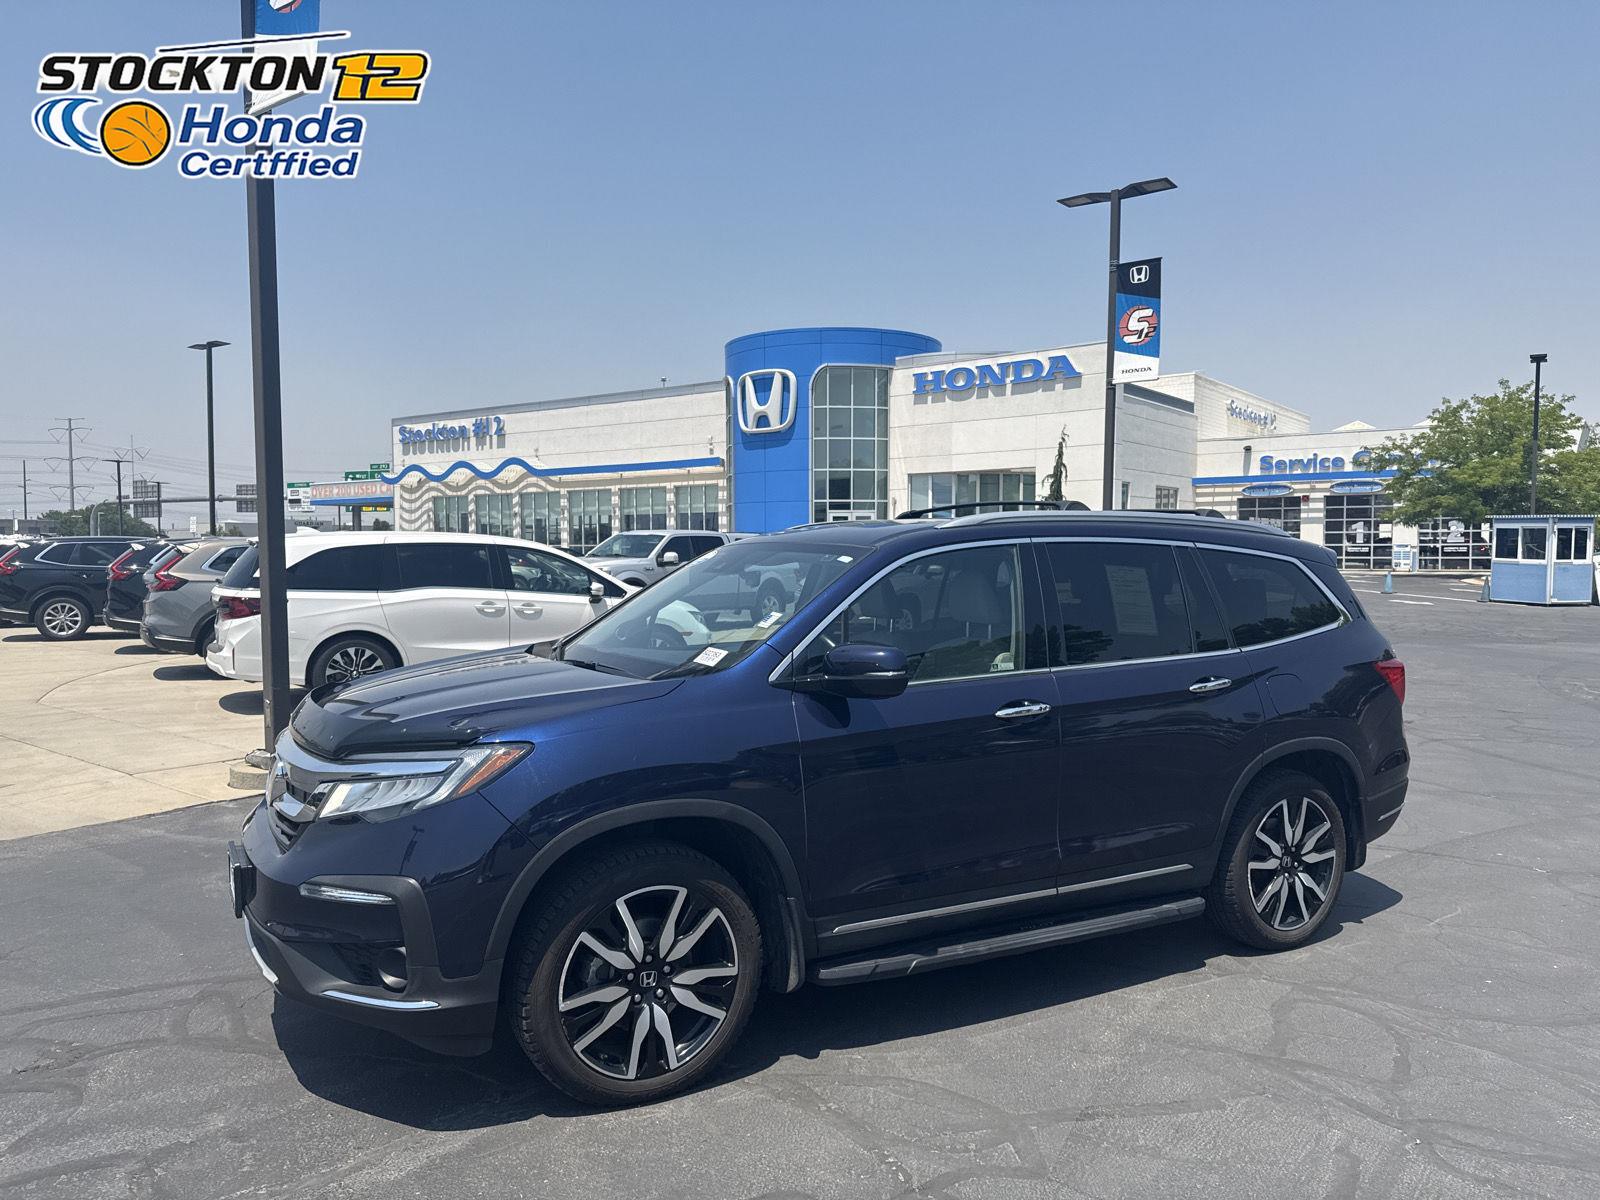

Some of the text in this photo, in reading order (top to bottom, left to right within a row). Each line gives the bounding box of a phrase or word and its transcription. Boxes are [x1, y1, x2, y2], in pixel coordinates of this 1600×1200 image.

[911, 354, 1083, 396] HONDA
[1120, 366, 1153, 375] HONDA
[398, 416, 506, 443] Stockton #12
[1259, 452, 1345, 474] Service
[311, 486, 334, 498] OVER
[335, 485, 352, 497] 200
[353, 483, 377, 496] USED
[1350, 521, 1365, 544] 1
[1446, 520, 1465, 543] 2
